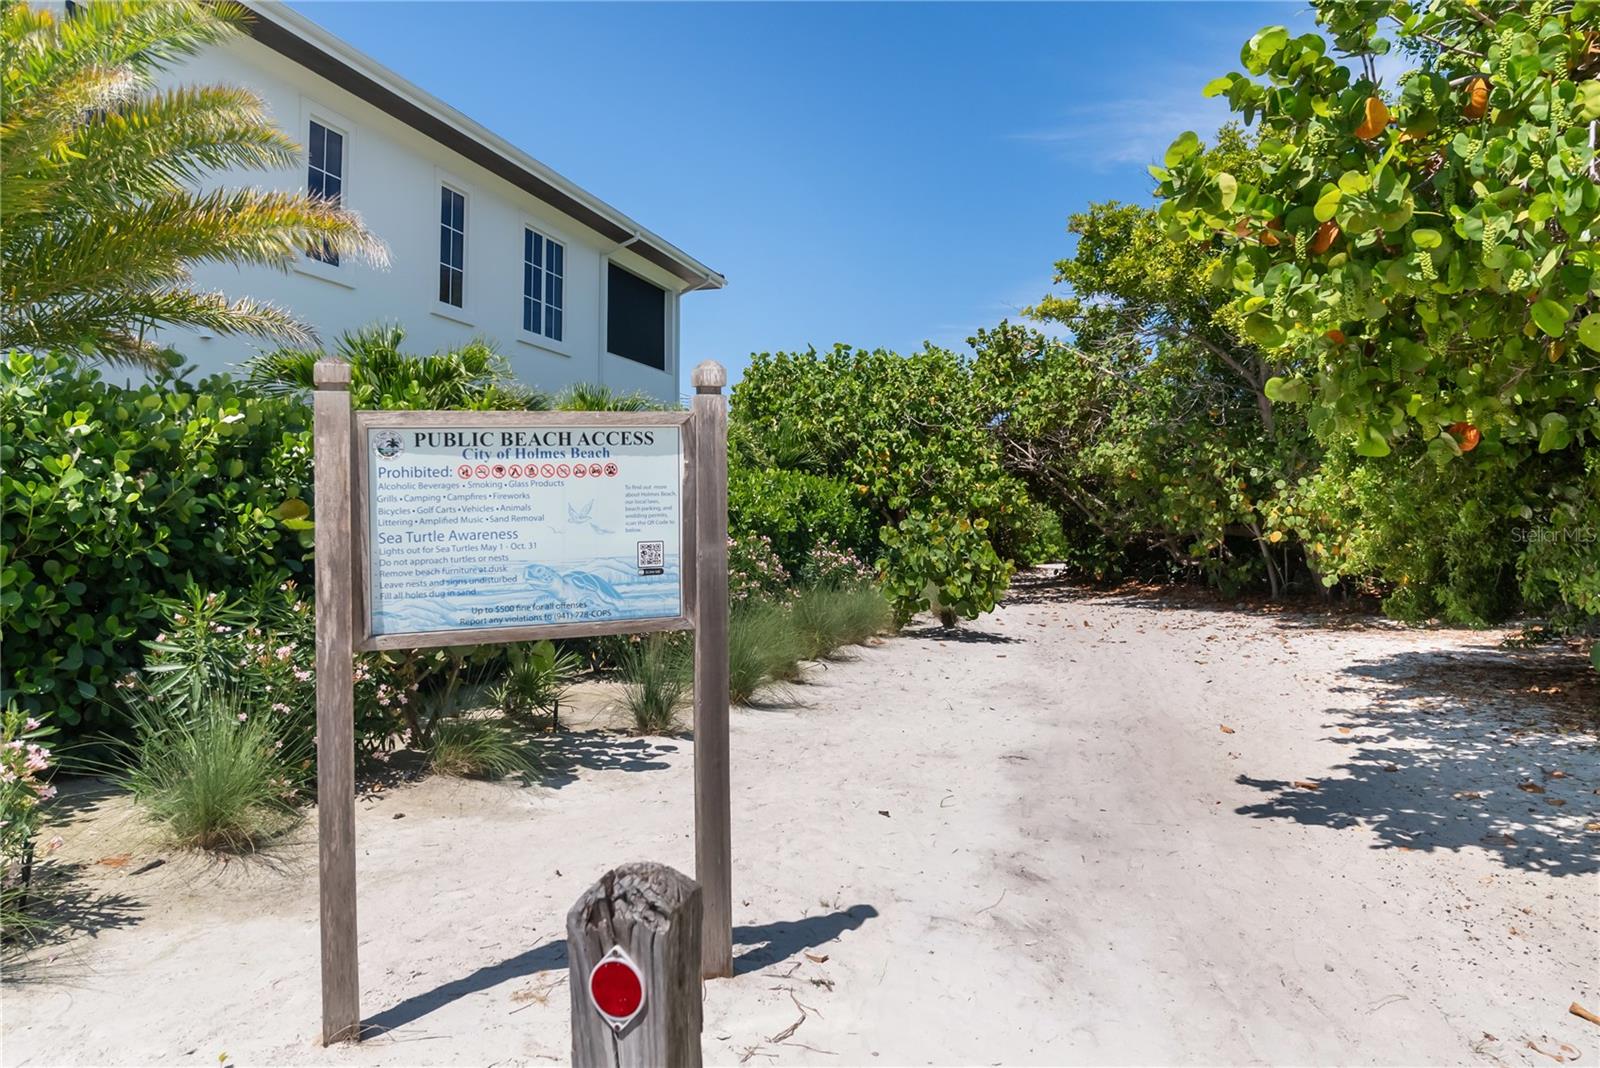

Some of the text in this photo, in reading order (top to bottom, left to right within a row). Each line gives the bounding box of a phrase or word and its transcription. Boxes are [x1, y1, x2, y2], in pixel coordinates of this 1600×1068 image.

[414, 432, 494, 448] PUBLIC
[501, 431, 572, 447] BEACH
[577, 431, 654, 446] ACCESS
[462, 447, 611, 462] City of Holmes Beach
[378, 465, 453, 479] Prohibited:
[378, 479, 565, 492] Alcoholic Beverages Smoking Glass Products
[376, 492, 530, 504] Grills Camping Campfires Fireworks
[378, 504, 532, 517] Bicycles Golf Carts Vehicles Animals
[378, 514, 545, 528] Littering Amplified Music Sand Removal
[378, 529, 519, 544] Sea Turtle Awareness
[379, 547, 405, 557] Lights
[422, 546, 434, 554] for
[435, 545, 451, 553] Sea
[450, 544, 479, 553] Turtles
[480, 543, 497, 553] May
[510, 542, 526, 550] Oct.
[528, 542, 537, 550] 31
[378, 559, 391, 567] Do
[409, 557, 449, 567] approach
[450, 555, 477, 564] turtles
[488, 554, 509, 562] nests
[379, 570, 414, 578] Remove
[415, 568, 441, 576] beach
[441, 567, 479, 575] furniture
[488, 565, 509, 573] dusk
[379, 581, 404, 590] Leave
[405, 580, 428, 588] nests
[428, 579, 445, 587] and
[469, 575, 518, 585] undisturbed
[380, 592, 393, 600] Fill
[393, 592, 403, 600] all
[405, 591, 428, 599] holes
[428, 590, 446, 599] dug
[446, 589, 456, 597] in
[471, 601, 588, 615] Up to $500 fine for all offenses
[459, 618, 487, 626] Report
[488, 617, 503, 625] any
[504, 614, 543, 623] violations
[544, 613, 552, 621] to
